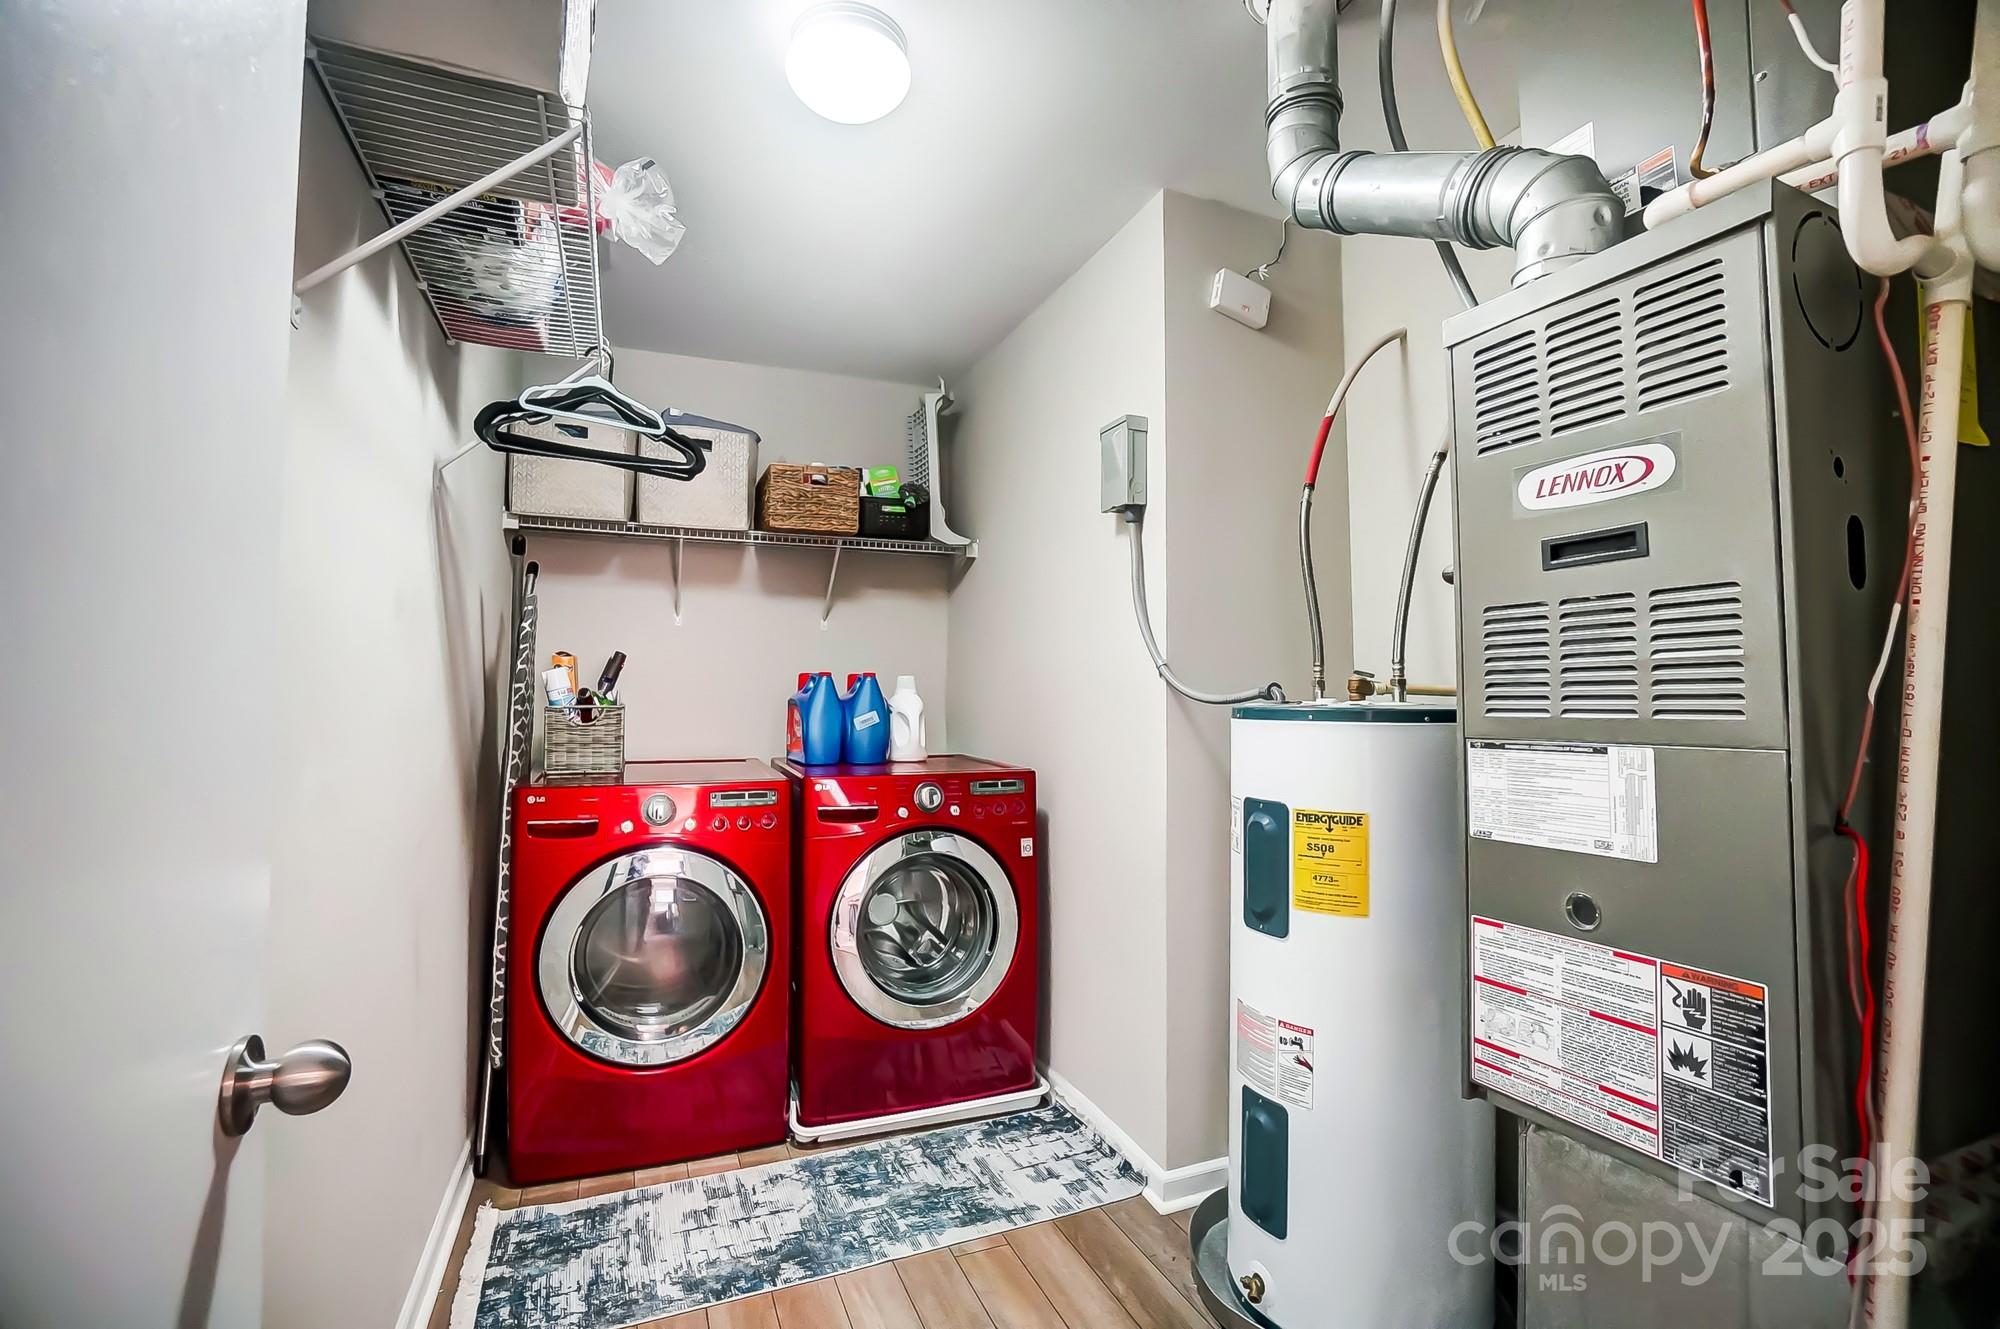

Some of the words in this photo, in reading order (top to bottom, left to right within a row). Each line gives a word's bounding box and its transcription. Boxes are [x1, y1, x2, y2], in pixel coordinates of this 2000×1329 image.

[1535, 460, 1630, 500] LENNOX
[1911, 522, 1926, 595] DRINKING
[1295, 812, 1364, 829] ENERGYGUIDE
